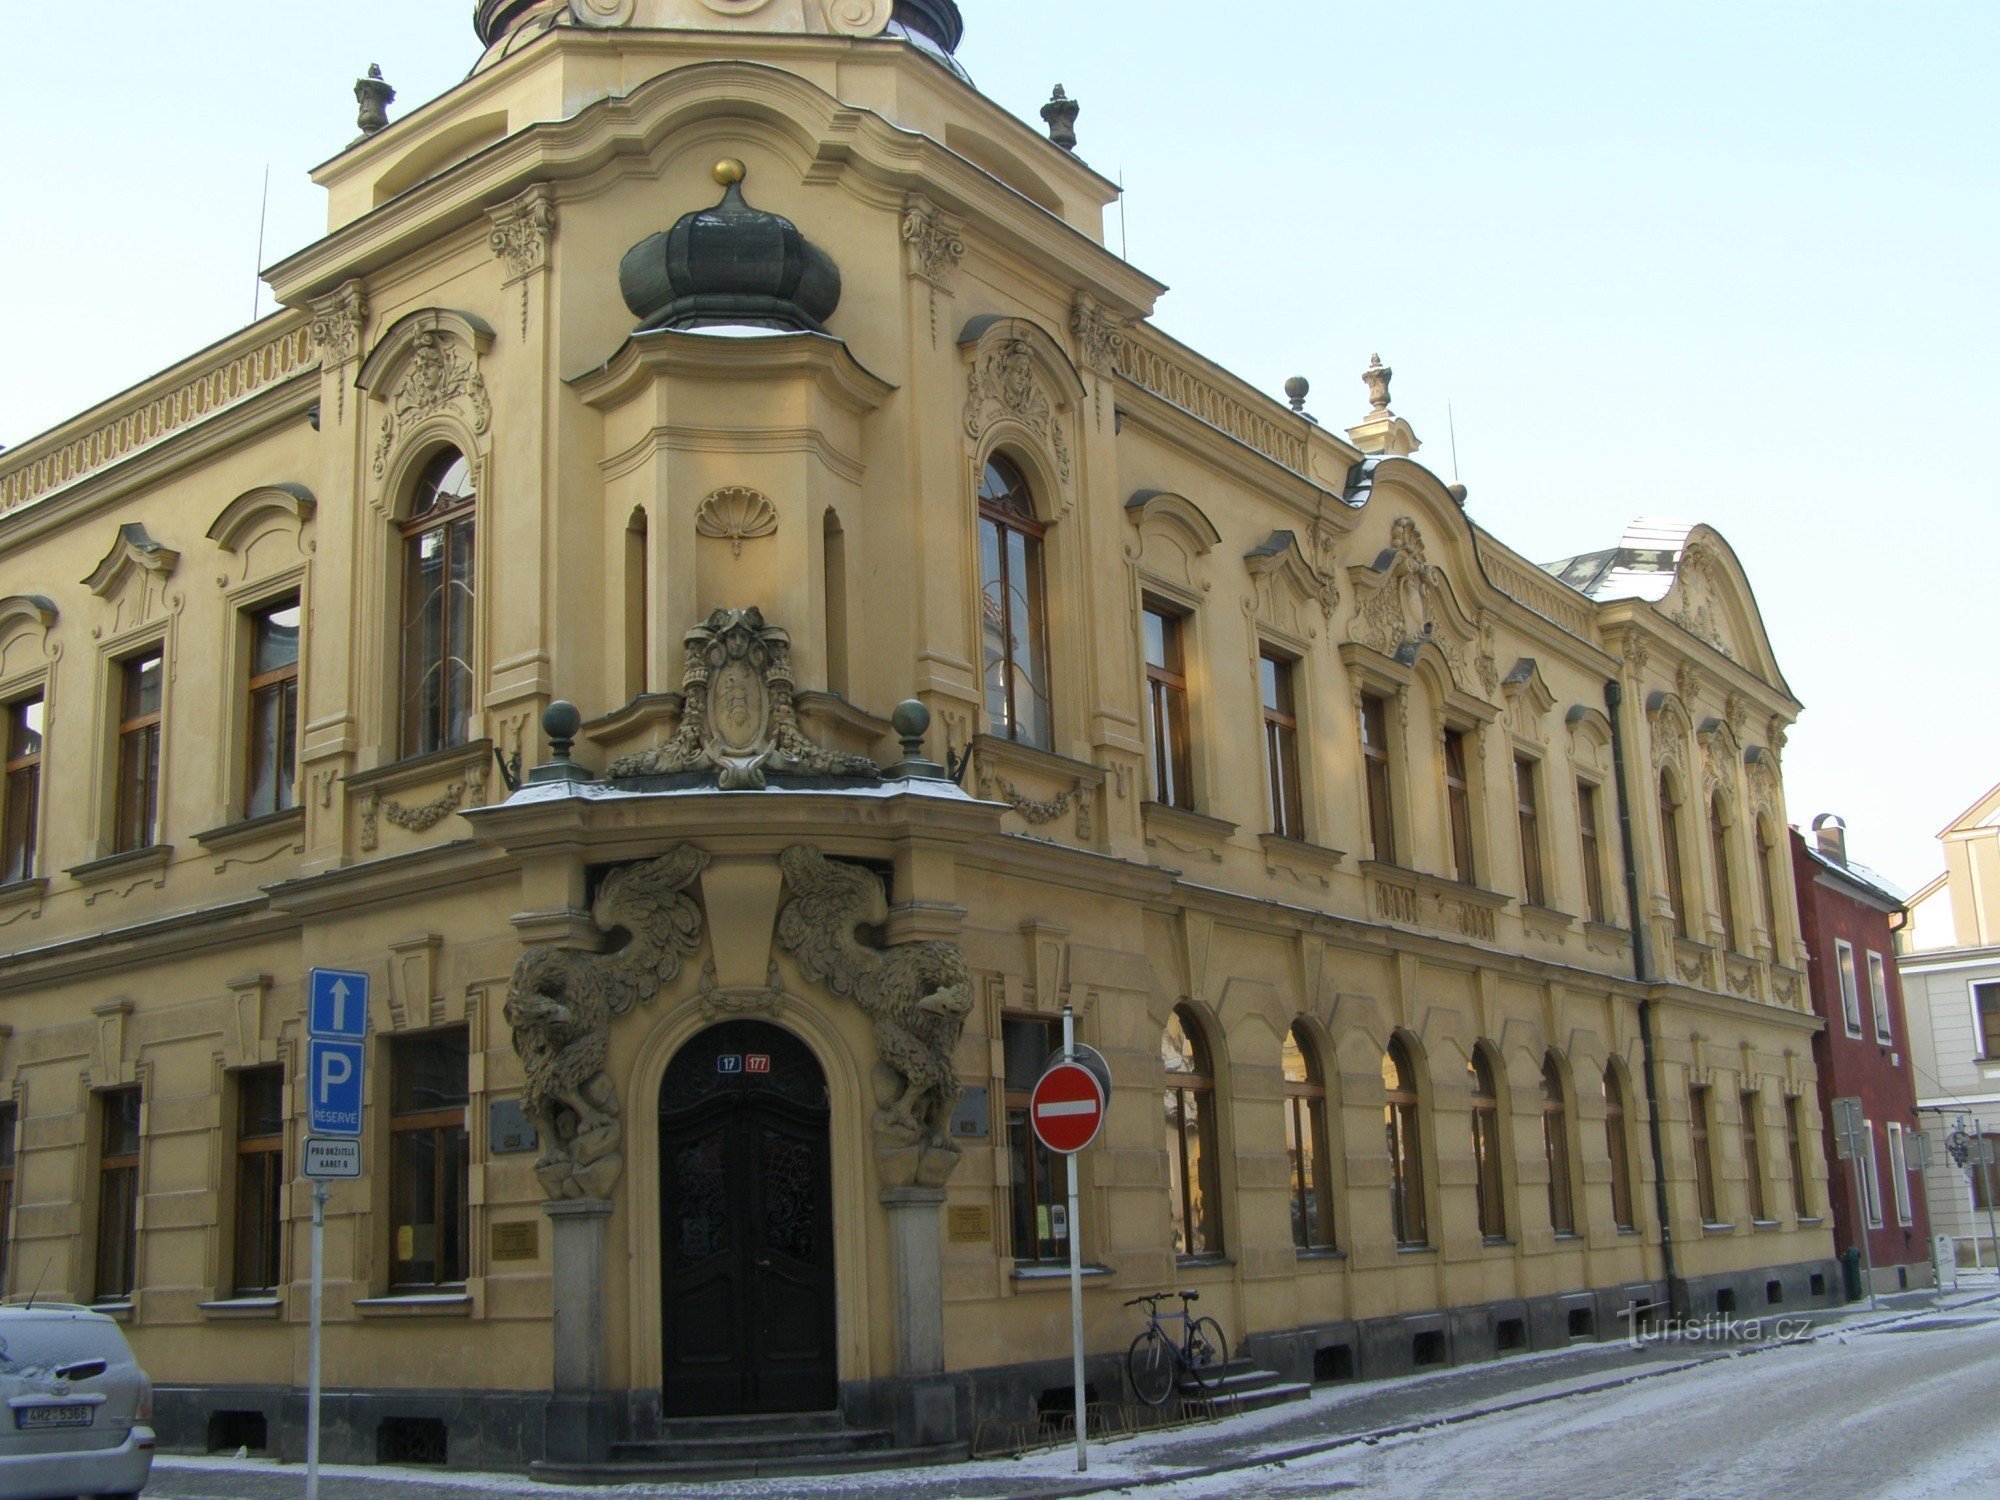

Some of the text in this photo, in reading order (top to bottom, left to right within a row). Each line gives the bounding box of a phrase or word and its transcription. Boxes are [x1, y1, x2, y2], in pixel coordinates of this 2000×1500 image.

[724, 1058, 735, 1070] 17
[750, 1058, 767, 1070] 177
[321, 1052, 352, 1104] P
[315, 1109, 358, 1124] RÉSERVÉ
[312, 1147, 324, 1155] PRO
[320, 1160, 342, 1169] KARET
[30, 1408, 52, 1421] 4H2
